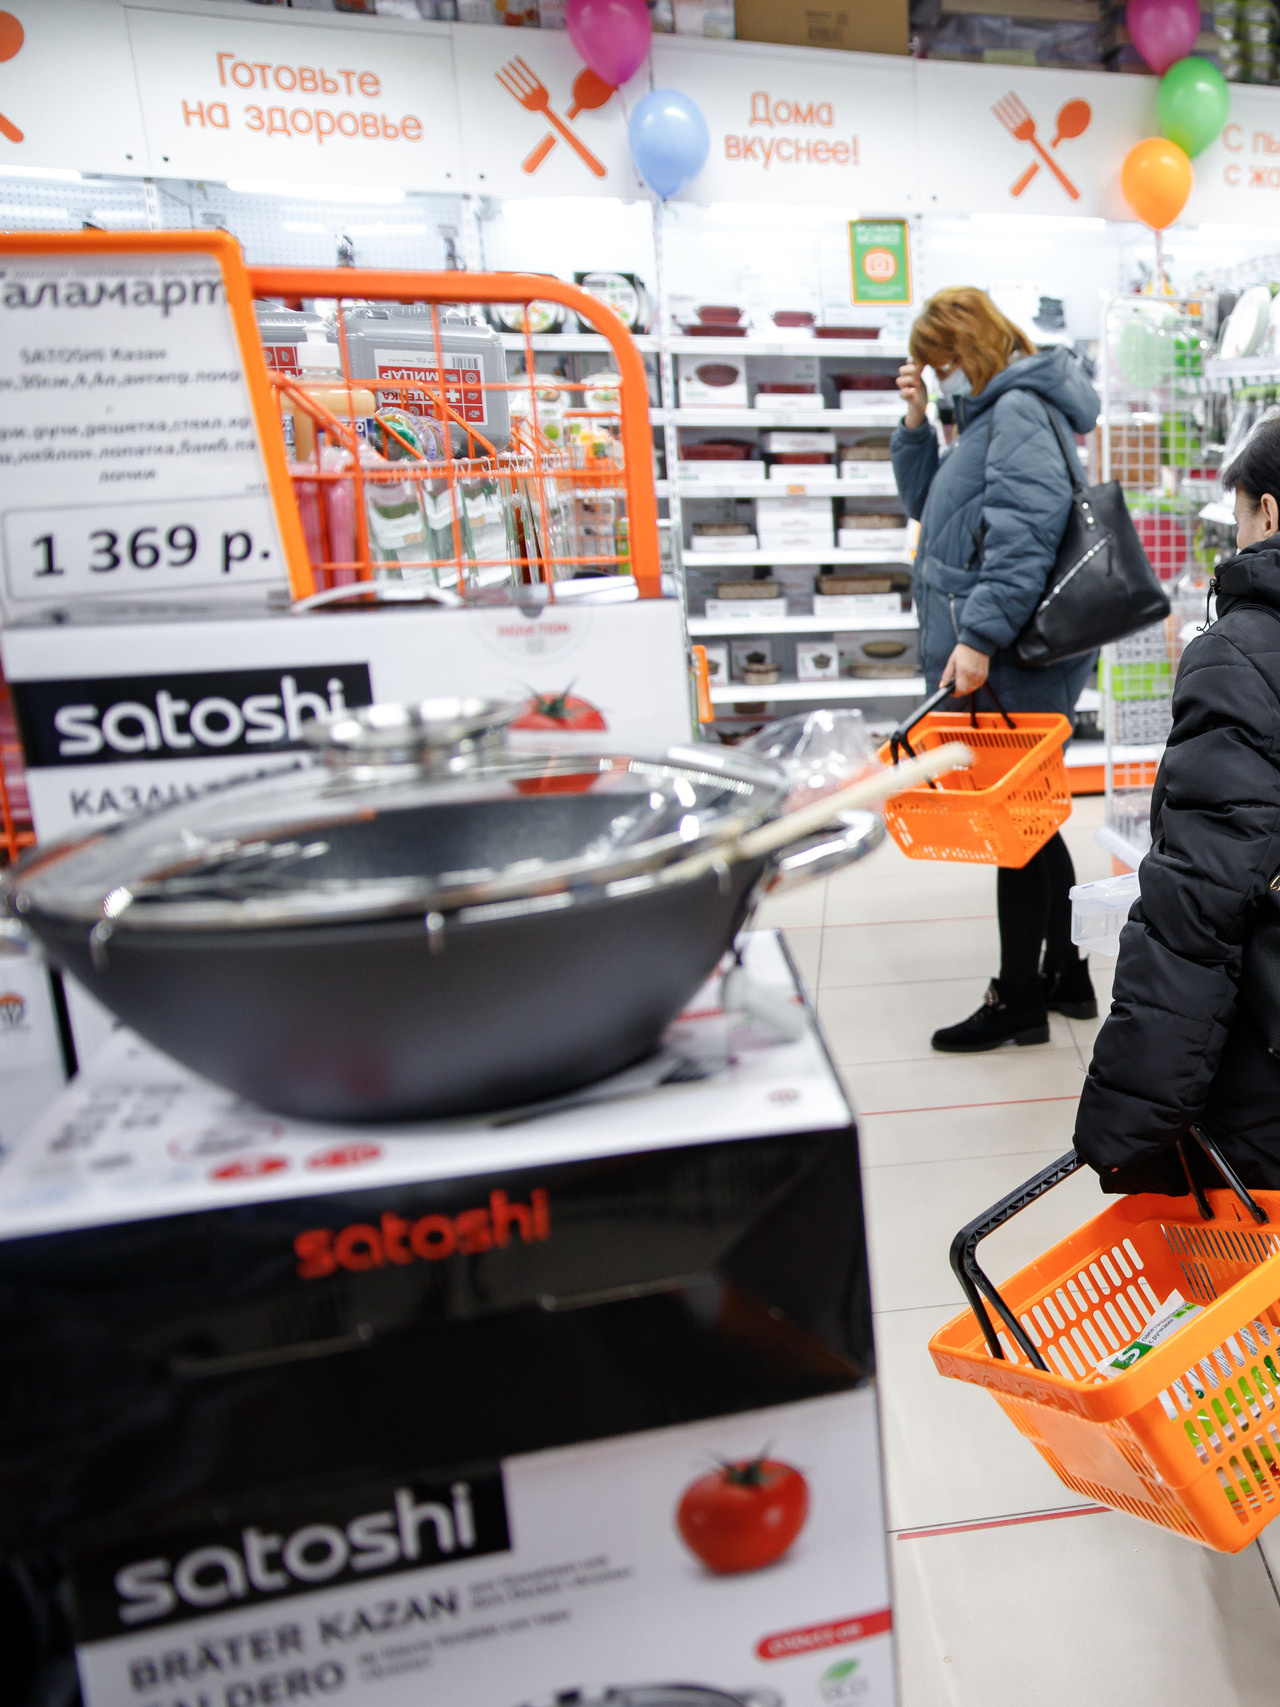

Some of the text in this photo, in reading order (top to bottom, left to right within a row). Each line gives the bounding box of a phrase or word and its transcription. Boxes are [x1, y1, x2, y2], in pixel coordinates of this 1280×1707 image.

[216, 51, 381, 97] Готовьте
[181, 99, 423, 144] на здоровье
[749, 91, 834, 127] Дома
[725, 135, 859, 170] вкуснее!
[1223, 123, 1244, 153] С
[1224, 163, 1241, 188] с
[0, 278, 226, 318] аламарт
[32, 523, 272, 577] 1 369 р.
[295, 1188, 551, 1279] satoshi
[114, 1482, 477, 1625] satoshi
[316, 1587, 460, 1647] KAZAN
